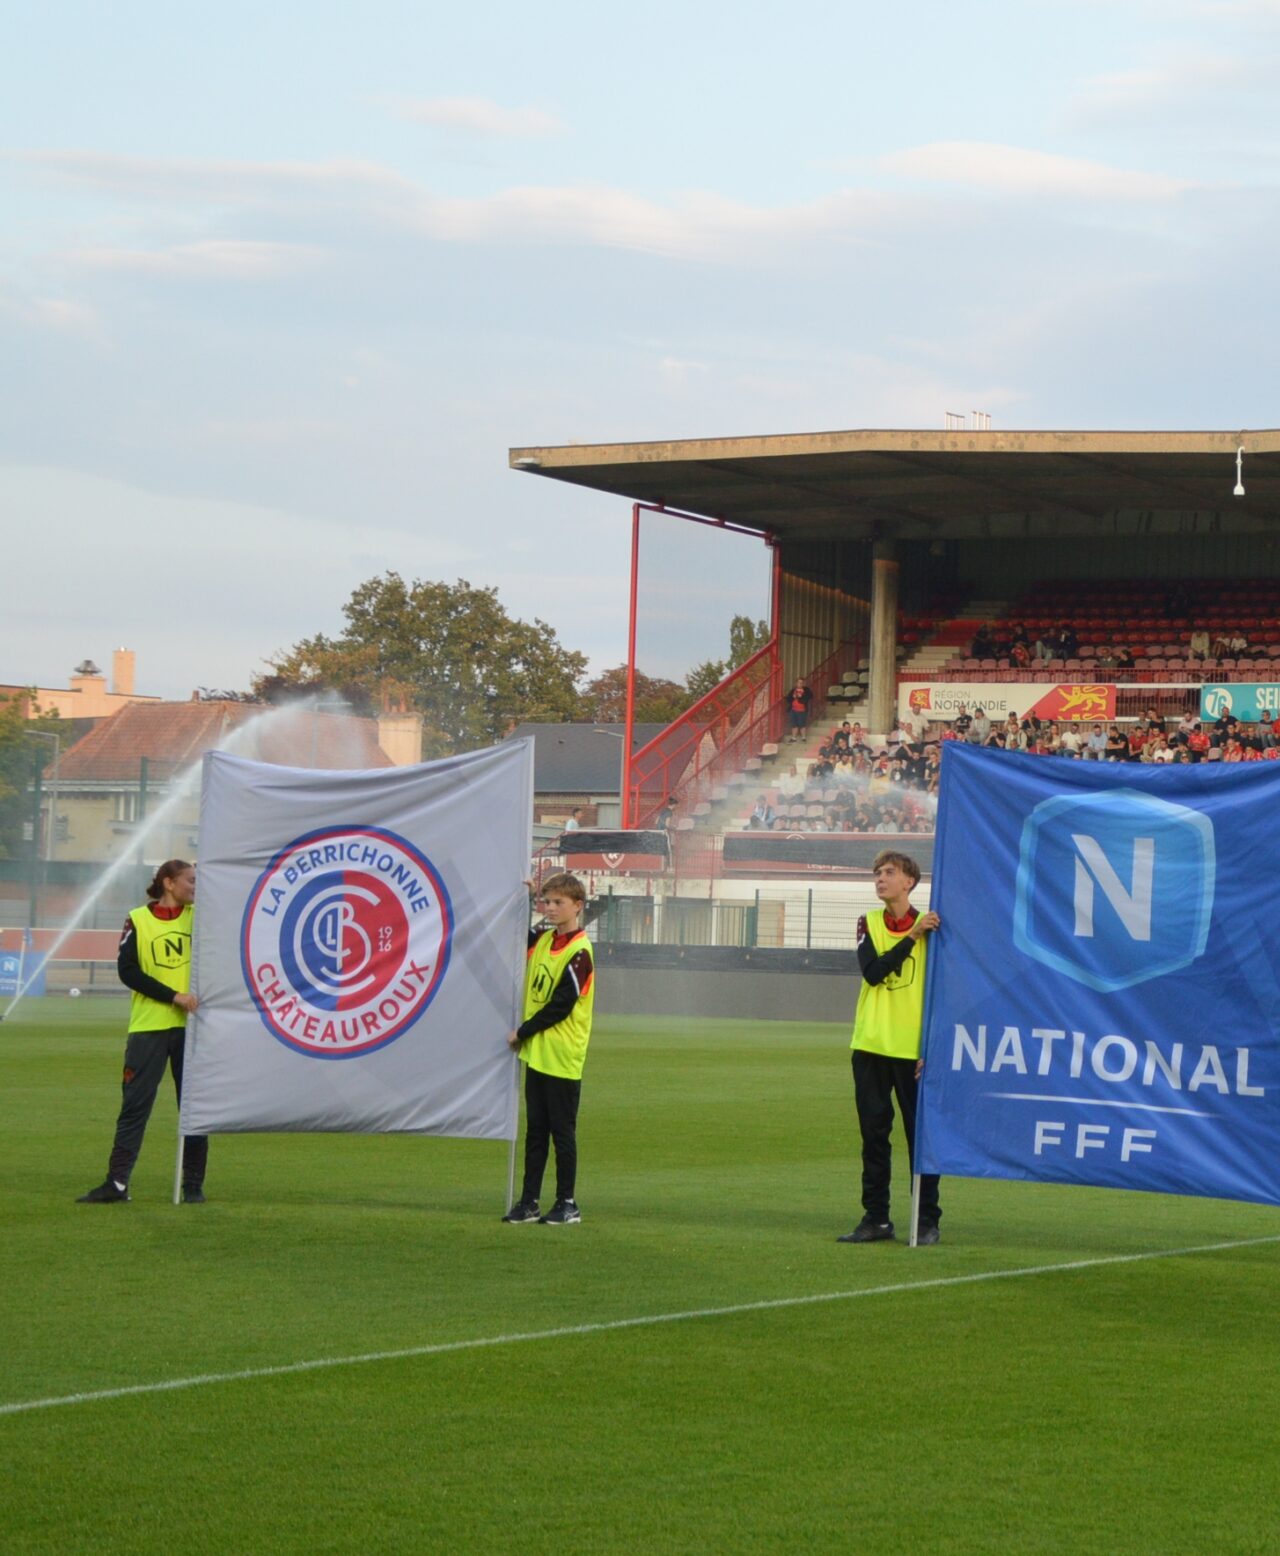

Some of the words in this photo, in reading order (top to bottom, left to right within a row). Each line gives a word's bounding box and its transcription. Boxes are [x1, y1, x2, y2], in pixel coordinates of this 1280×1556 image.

[934, 687, 971, 699] RÉGION
[262, 885, 286, 916] LA
[284, 843, 430, 914] BERRICHONNE
[1071, 834, 1154, 942] N
[378, 926, 392, 939] 19
[164, 937, 182, 957] N
[378, 940, 392, 952] 16
[3, 960, 15, 972] N
[257, 960, 430, 1043] CHÂTEAUROUX
[951, 1024, 1265, 1097] NATIONAL
